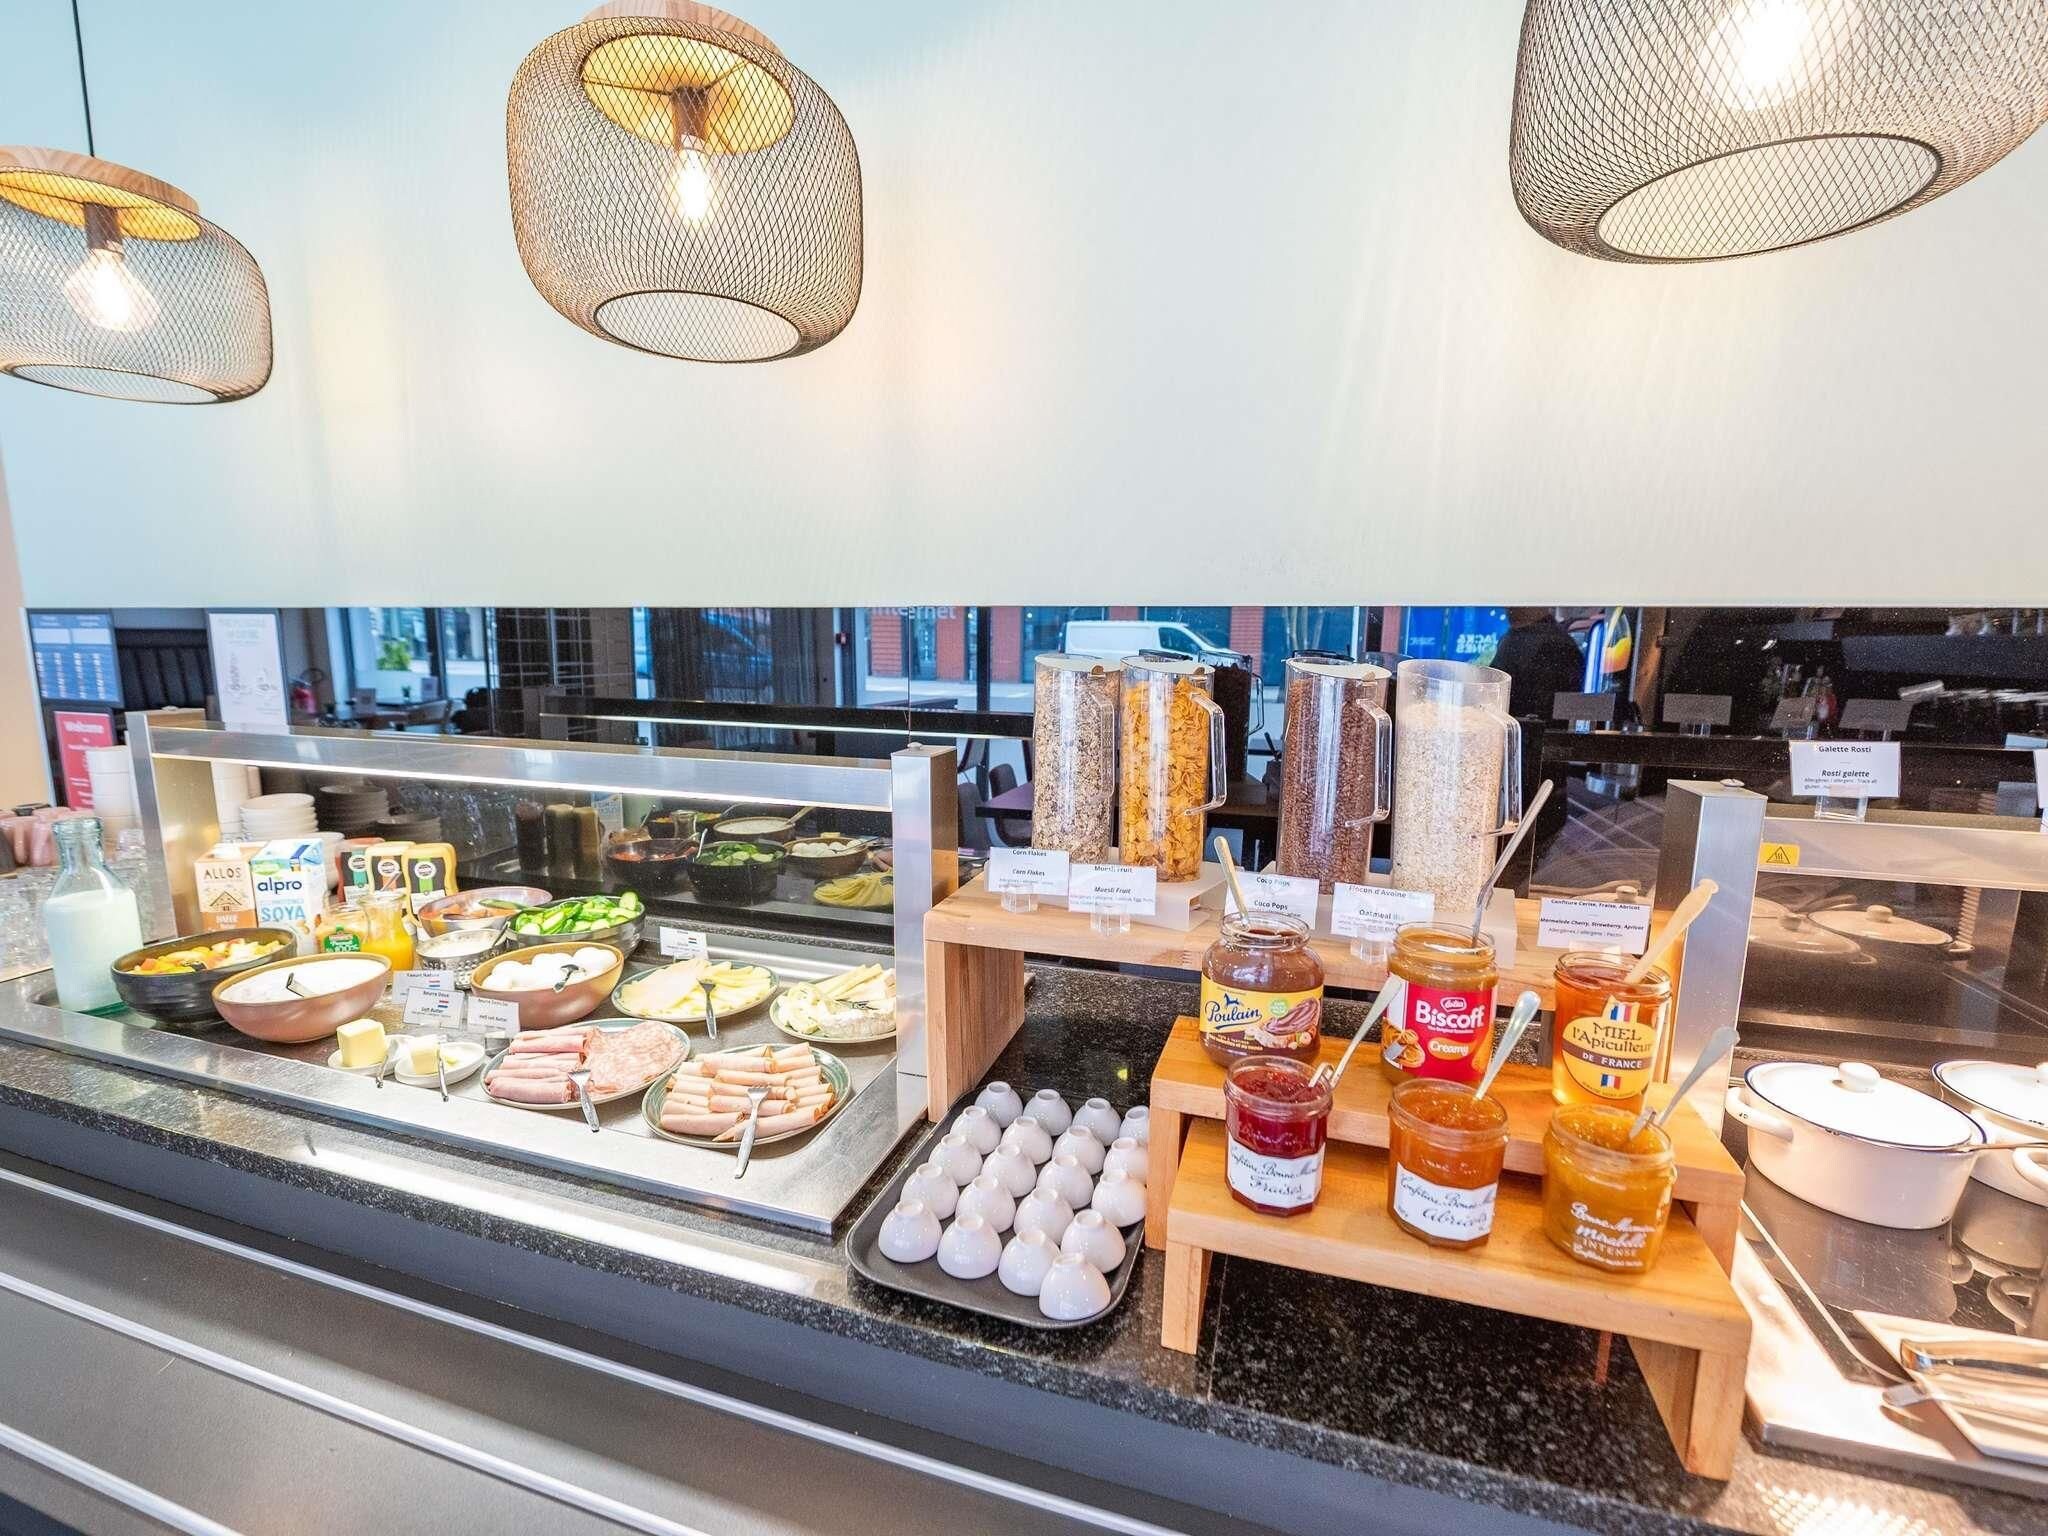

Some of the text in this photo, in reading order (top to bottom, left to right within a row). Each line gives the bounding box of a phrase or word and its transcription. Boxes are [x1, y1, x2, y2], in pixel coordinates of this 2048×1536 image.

[1821, 769, 1870, 779] Rosti galette
[1012, 849, 1047, 858] Corn Flakes
[203, 867, 242, 880] ALLOS
[1012, 868, 1046, 877] Corn Flakes
[257, 876, 303, 895] alpro
[1094, 886, 1131, 895] Muesli Fruit
[1254, 899, 1289, 911] Coco Pops
[261, 905, 306, 923] SOYA
[1205, 1000, 1262, 1023] Poulain
[1416, 1000, 1486, 1029] Biscoff
[1572, 1026, 1652, 1054] l'Apiculteur
[1592, 1022, 1642, 1041] MIEL
[1582, 1052, 1643, 1069] DE FRANCE
[1583, 1239, 1638, 1257] INTENSE
